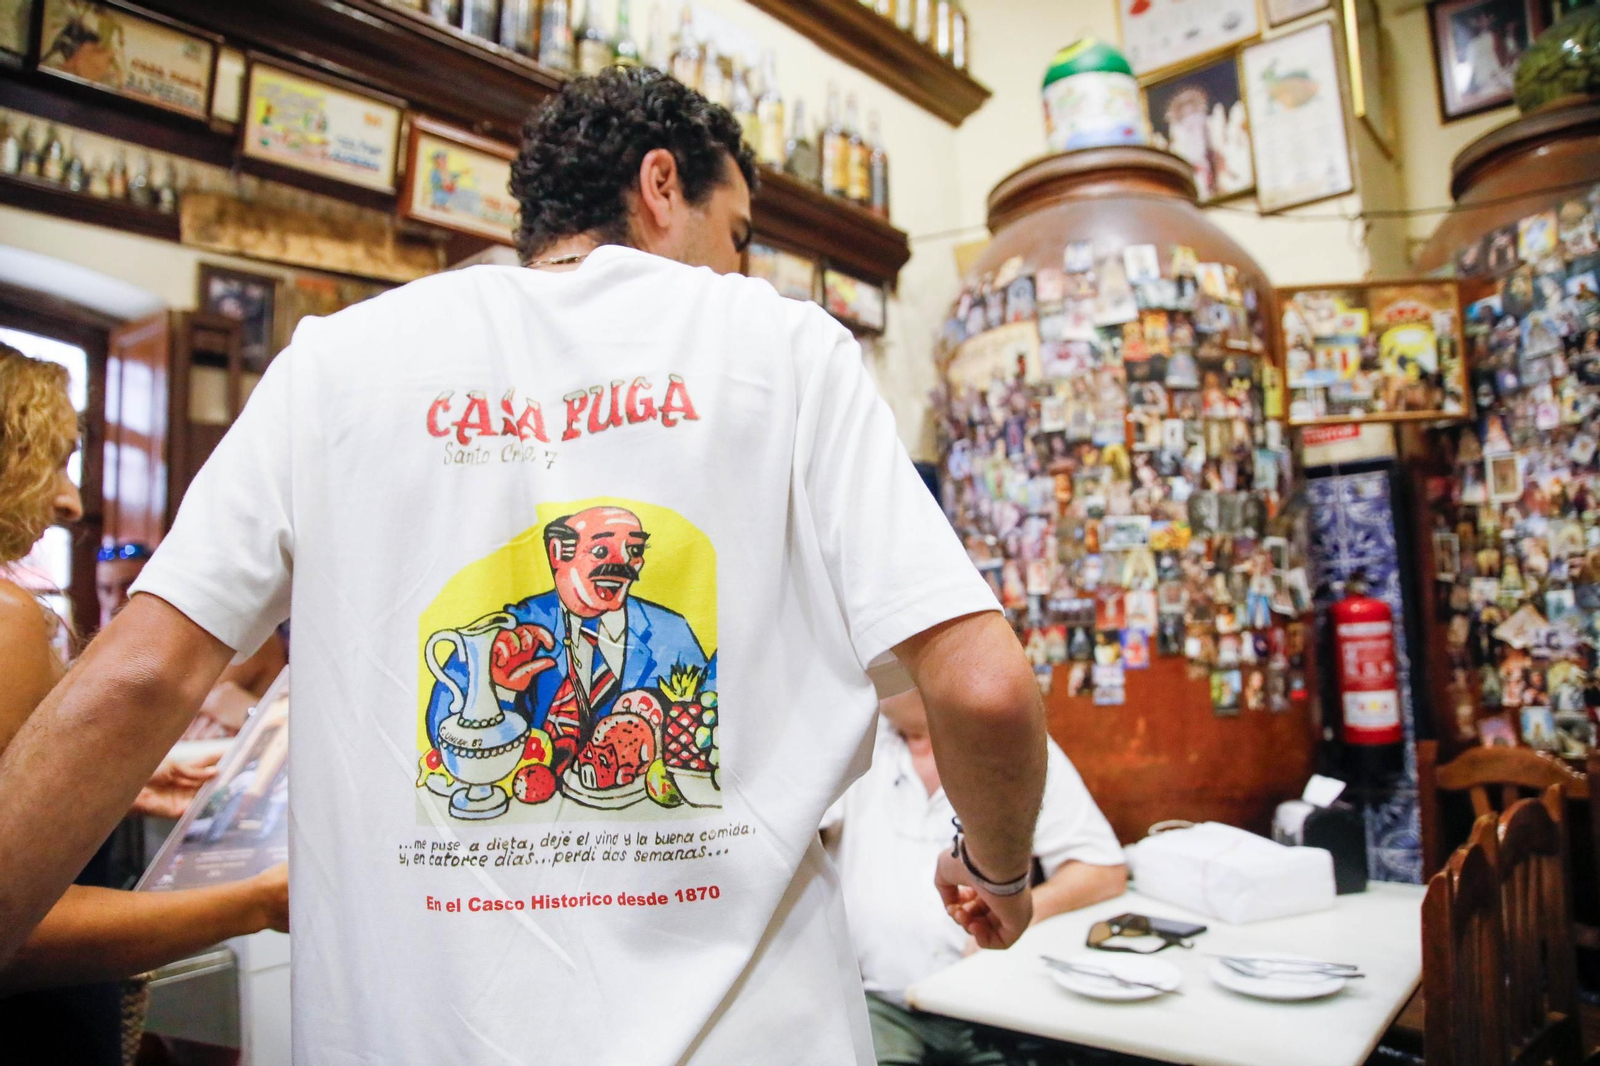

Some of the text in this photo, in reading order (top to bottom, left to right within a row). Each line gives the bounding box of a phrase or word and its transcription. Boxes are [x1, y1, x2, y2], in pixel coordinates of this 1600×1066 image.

[427, 374, 701, 446] CASA PUGA
[444, 442, 490, 465] Santo
[545, 451, 558, 469] 7
[431, 840, 461, 853] puse
[469, 842, 480, 851] a
[487, 837, 534, 852] dieta,
[576, 832, 590, 846] el
[595, 830, 619, 845] vino
[624, 833, 631, 846] y
[636, 832, 648, 845] la
[655, 831, 695, 845] buena
[413, 853, 426, 865] en
[428, 851, 489, 867] catorce
[602, 846, 627, 861] dos
[426, 885, 721, 913] En el Casco Historico desde 1870
